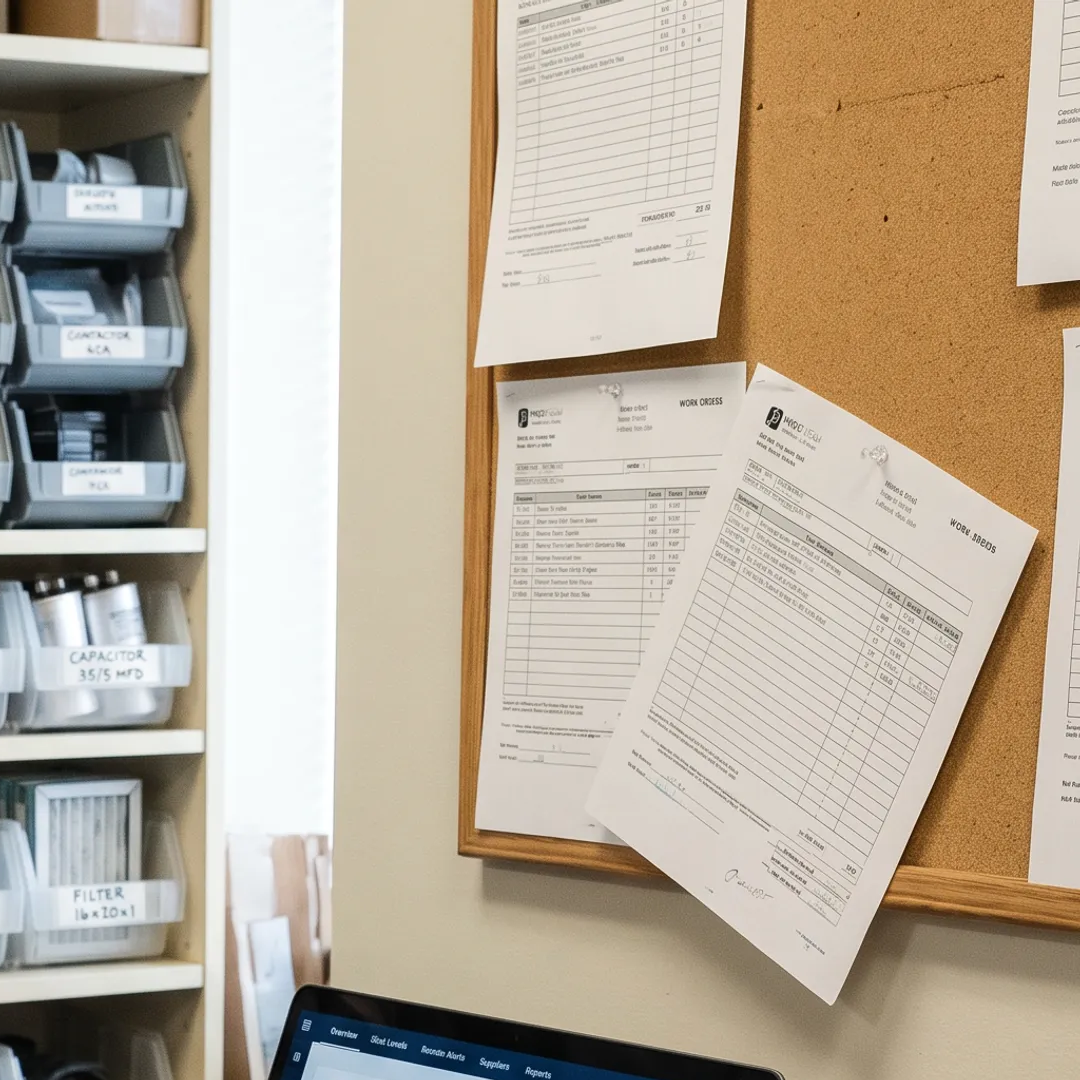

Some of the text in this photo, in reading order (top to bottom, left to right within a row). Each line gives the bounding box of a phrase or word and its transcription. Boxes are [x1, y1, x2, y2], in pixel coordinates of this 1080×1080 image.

[679, 398, 698, 408] WORK
[69, 650, 147, 664] CAPACITOR
[78, 668, 112, 683] 35/5
[73, 886, 126, 902] FILTER
